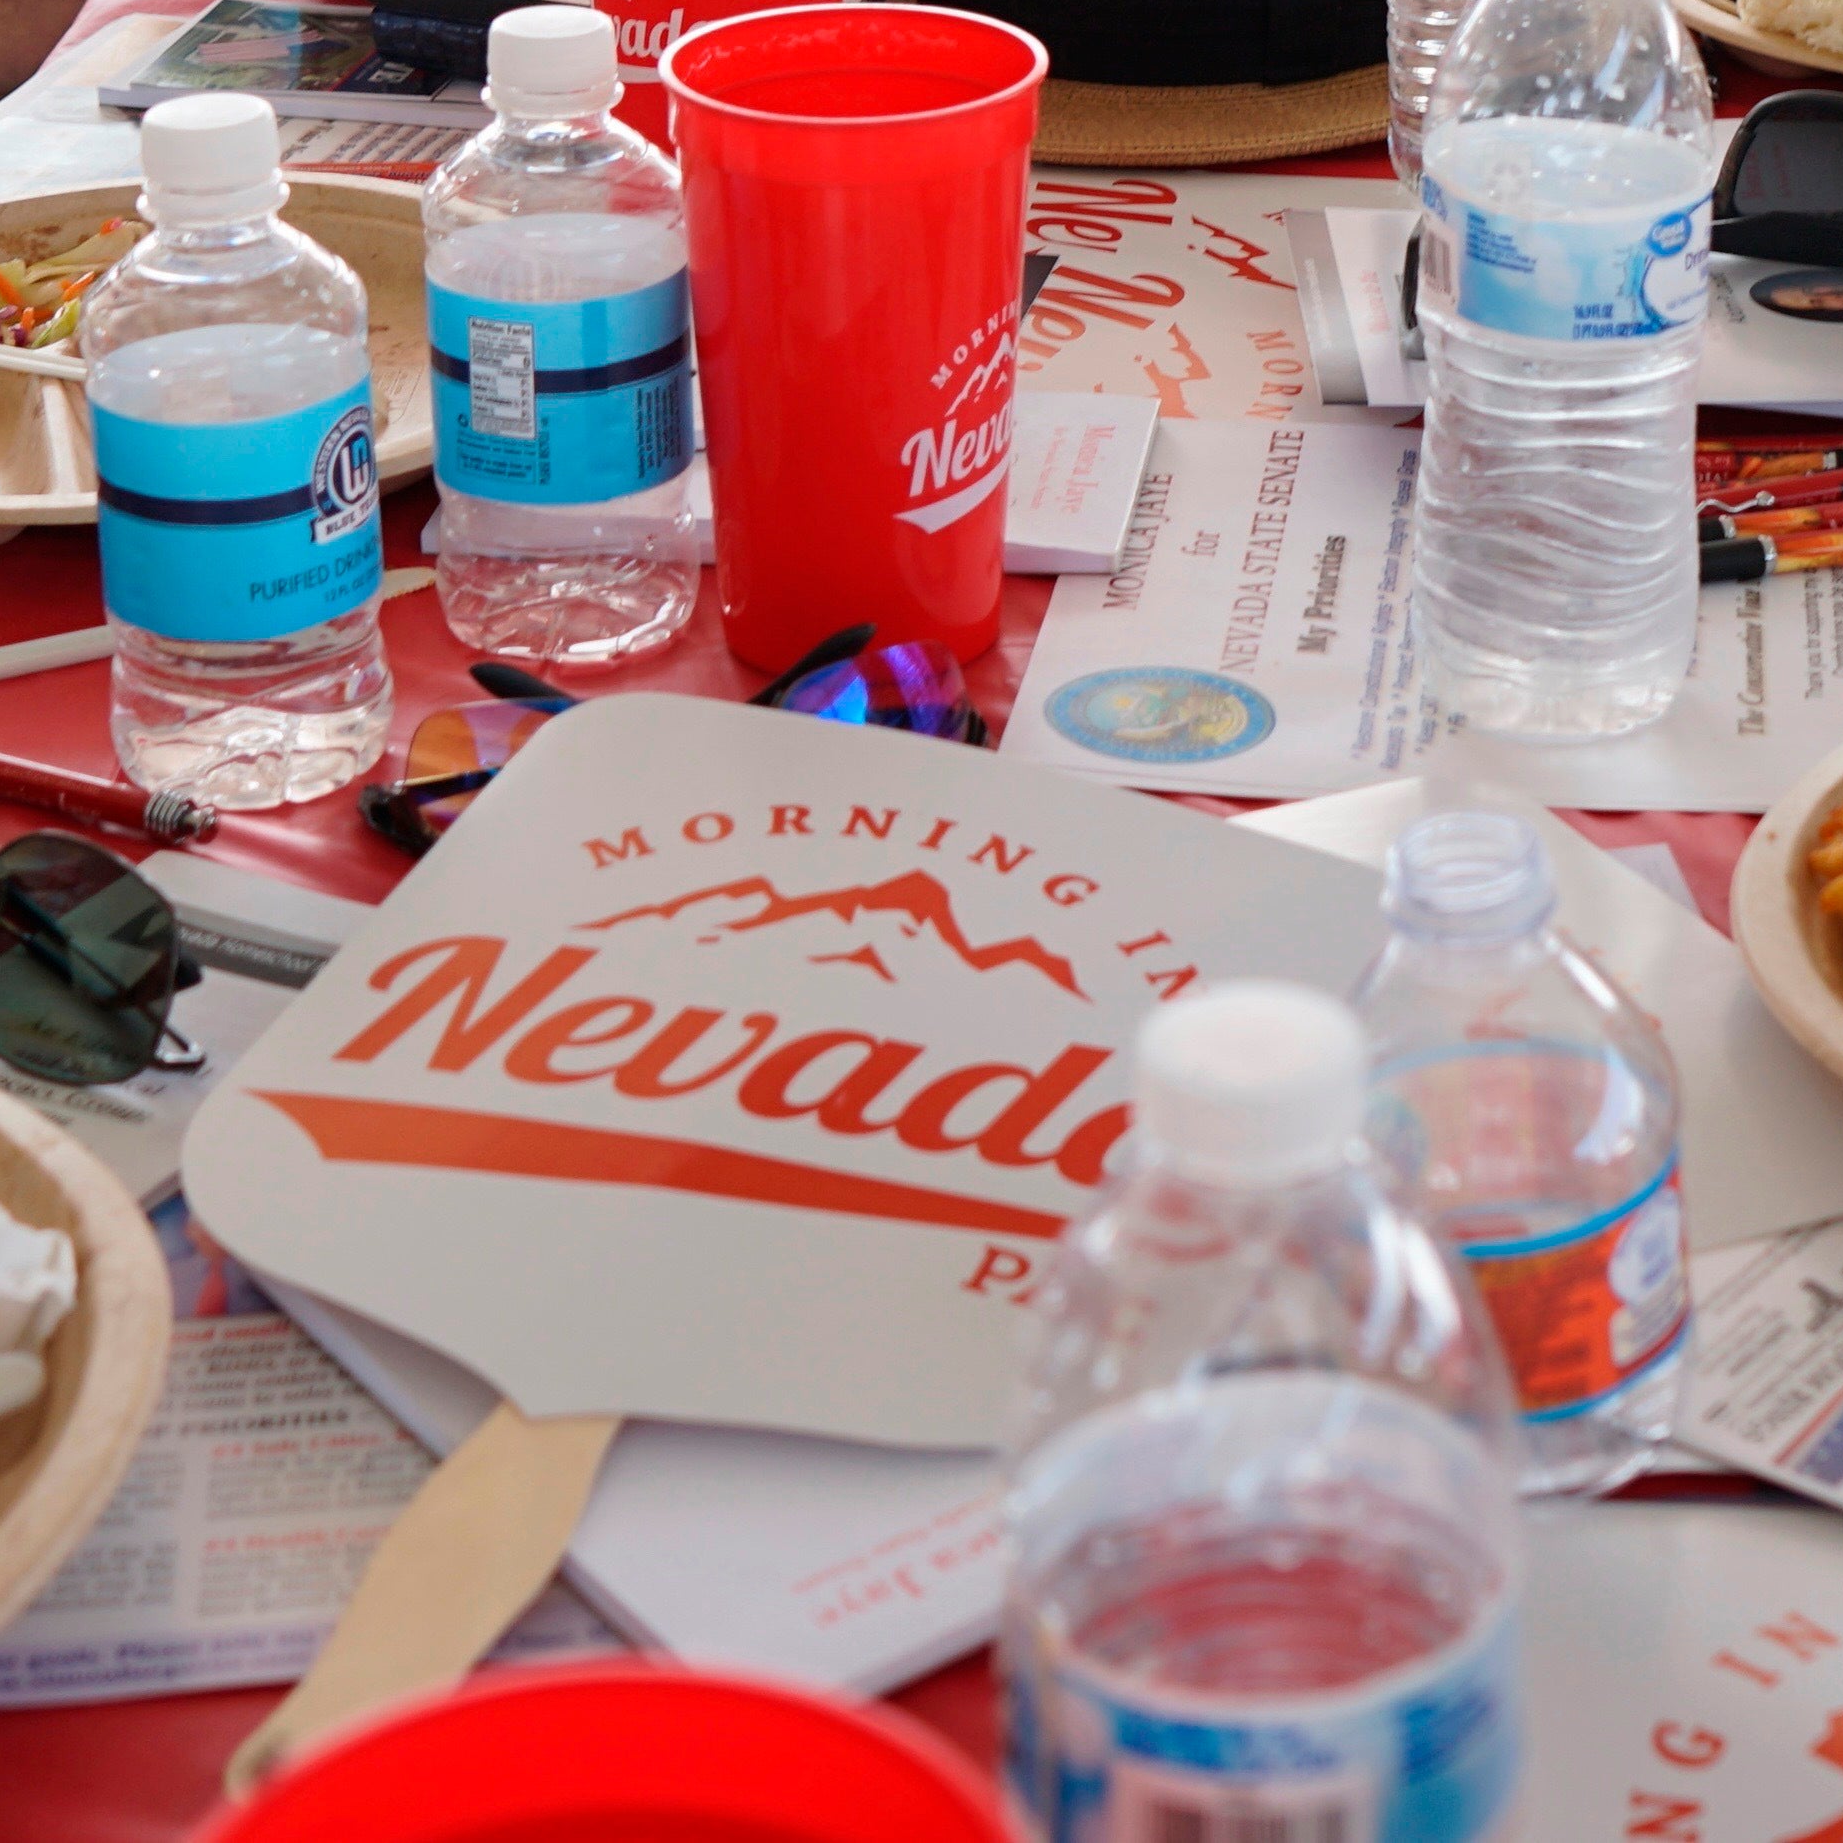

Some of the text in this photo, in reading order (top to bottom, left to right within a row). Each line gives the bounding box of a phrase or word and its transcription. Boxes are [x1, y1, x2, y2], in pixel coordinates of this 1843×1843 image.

[249, 565, 330, 602] PURIFIED
[1102, 471, 1174, 611] MONICA JAYE
[1181, 529, 1221, 557] for
[1219, 429, 1304, 674] NEVADA STATE SENATE
[1296, 534, 1347, 655] My Priorities
[1736, 709, 1764, 737] The
[580, 803, 1101, 910] MORNING
